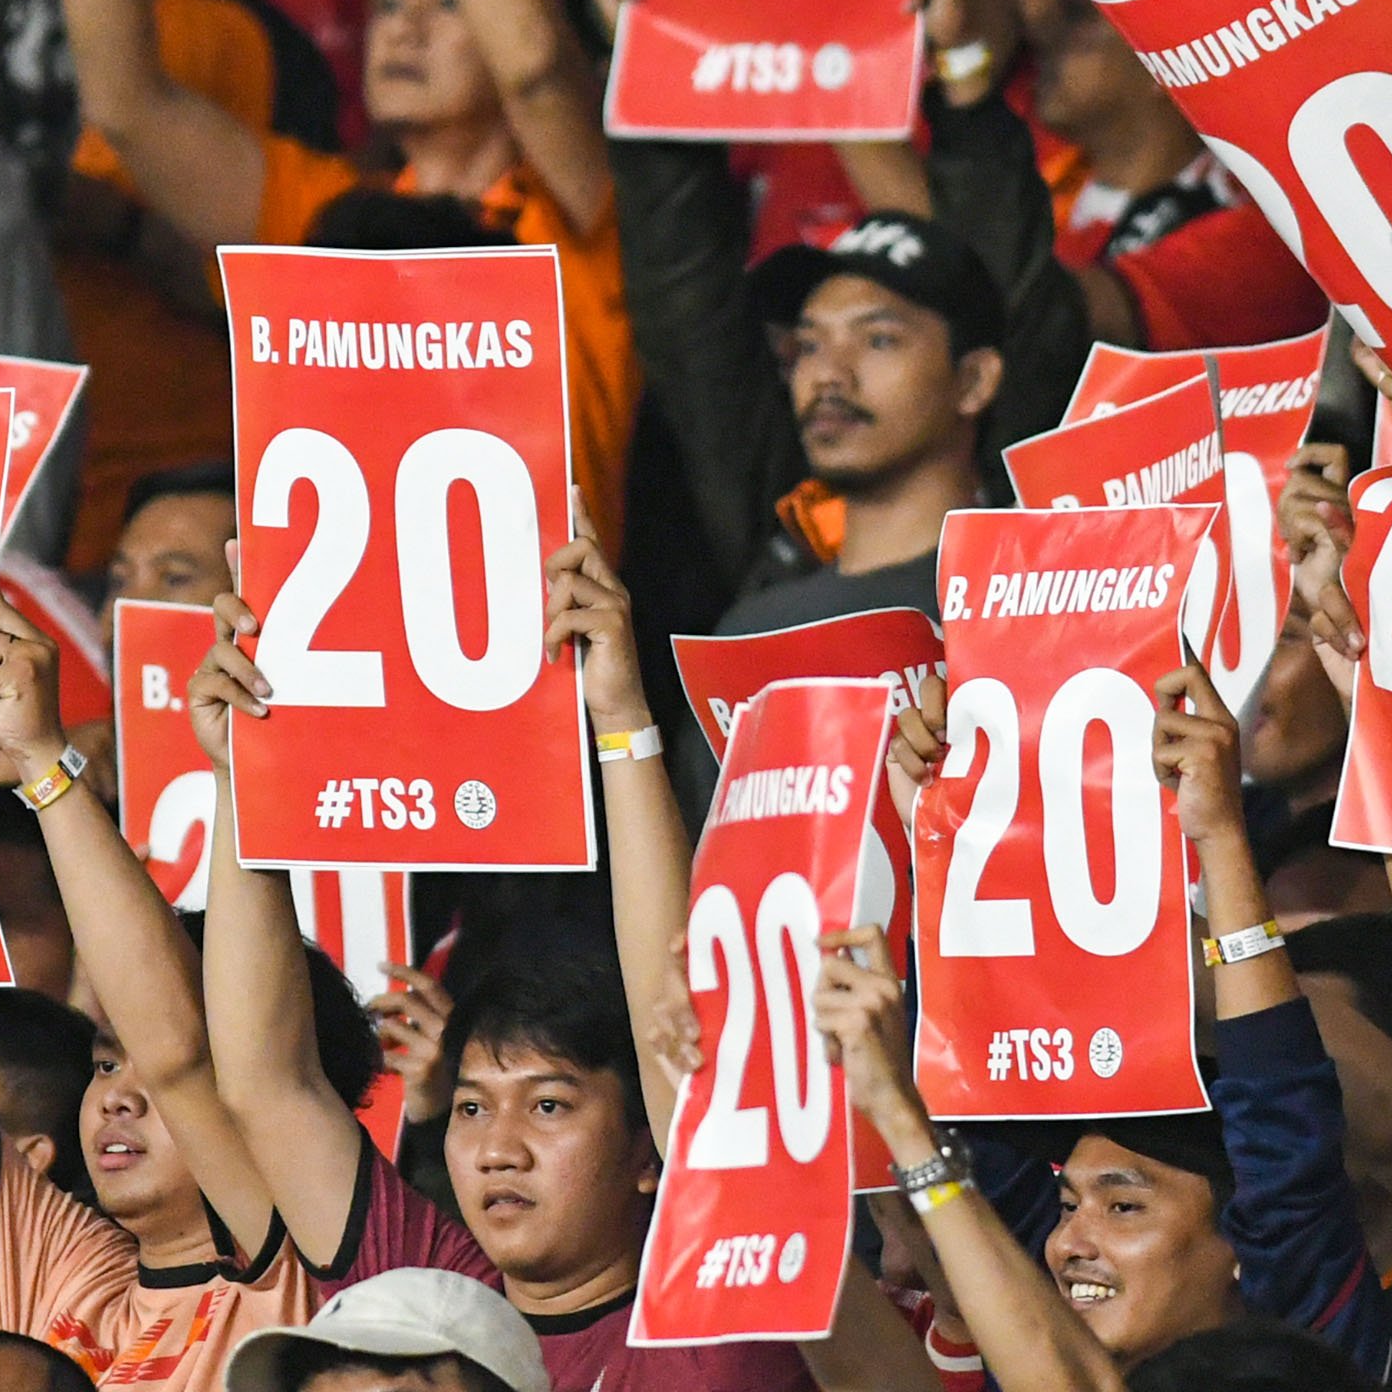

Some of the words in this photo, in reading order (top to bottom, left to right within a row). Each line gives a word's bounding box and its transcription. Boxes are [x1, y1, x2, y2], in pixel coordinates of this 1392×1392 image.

[692, 43, 804, 93] #TS3
[250, 314, 280, 365] B.
[288, 318, 534, 371] PAMUNGKAS
[251, 427, 544, 712] 20
[943, 575, 974, 622] B.
[982, 562, 1175, 619] PAMUNGKAS
[314, 777, 437, 831] #TS3
[939, 667, 1164, 959] 20
[688, 870, 832, 1170] 20
[986, 1027, 1075, 1083] #TS3
[695, 1234, 776, 1289] #TS3
